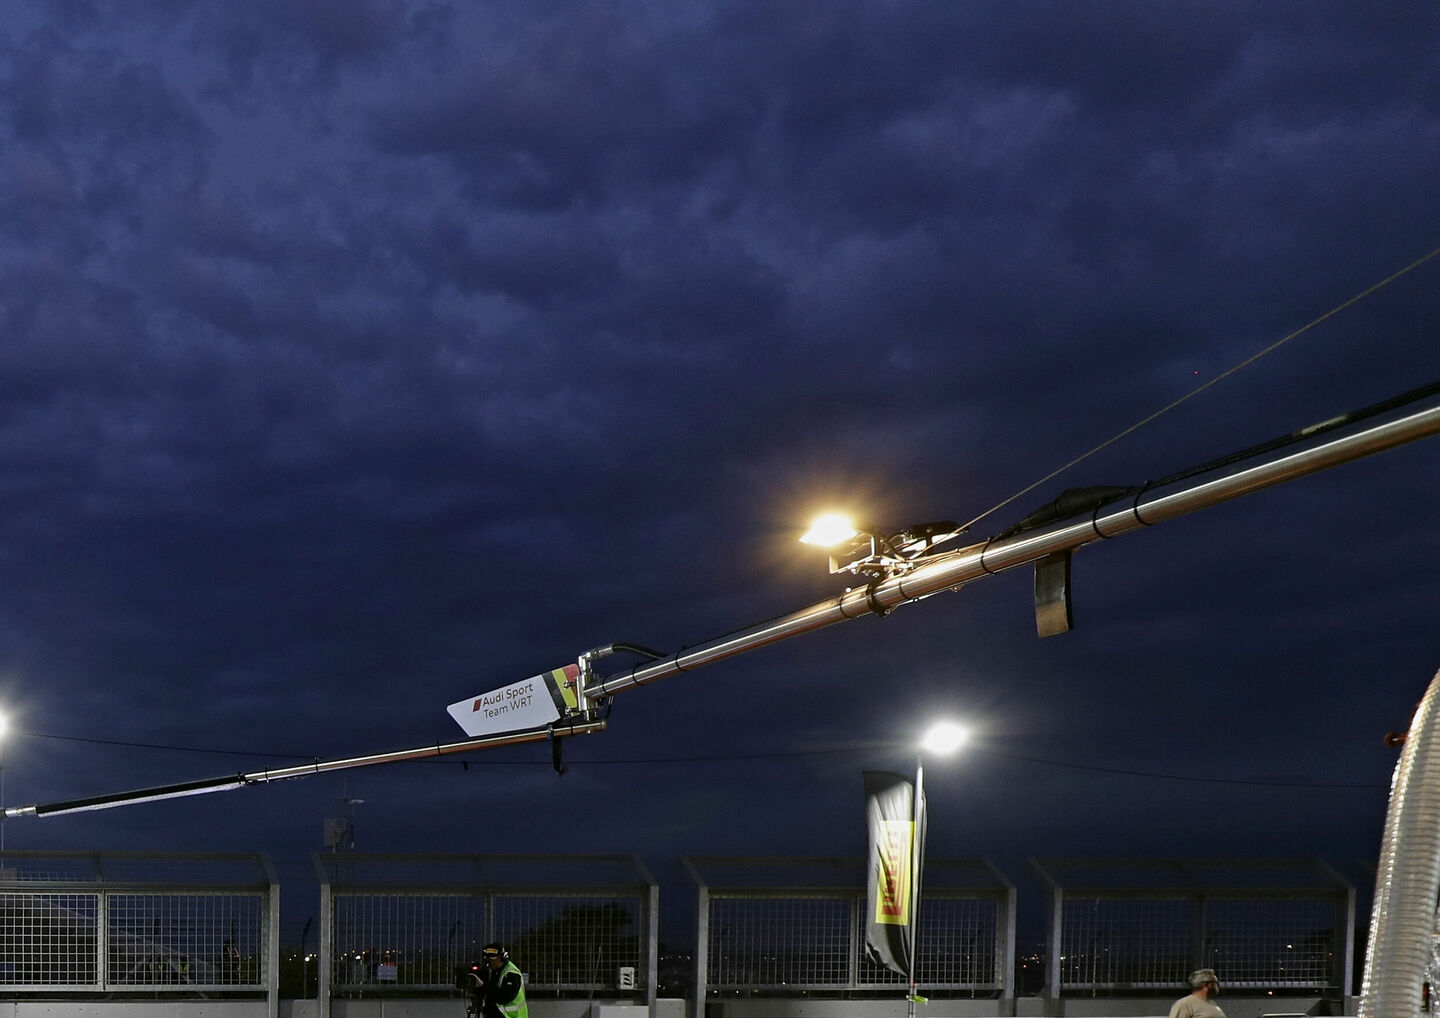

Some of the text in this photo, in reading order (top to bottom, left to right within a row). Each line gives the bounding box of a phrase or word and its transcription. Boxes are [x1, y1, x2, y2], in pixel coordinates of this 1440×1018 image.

[482, 683, 534, 707] Audi Sport
[484, 696, 533, 719] Team WRT
